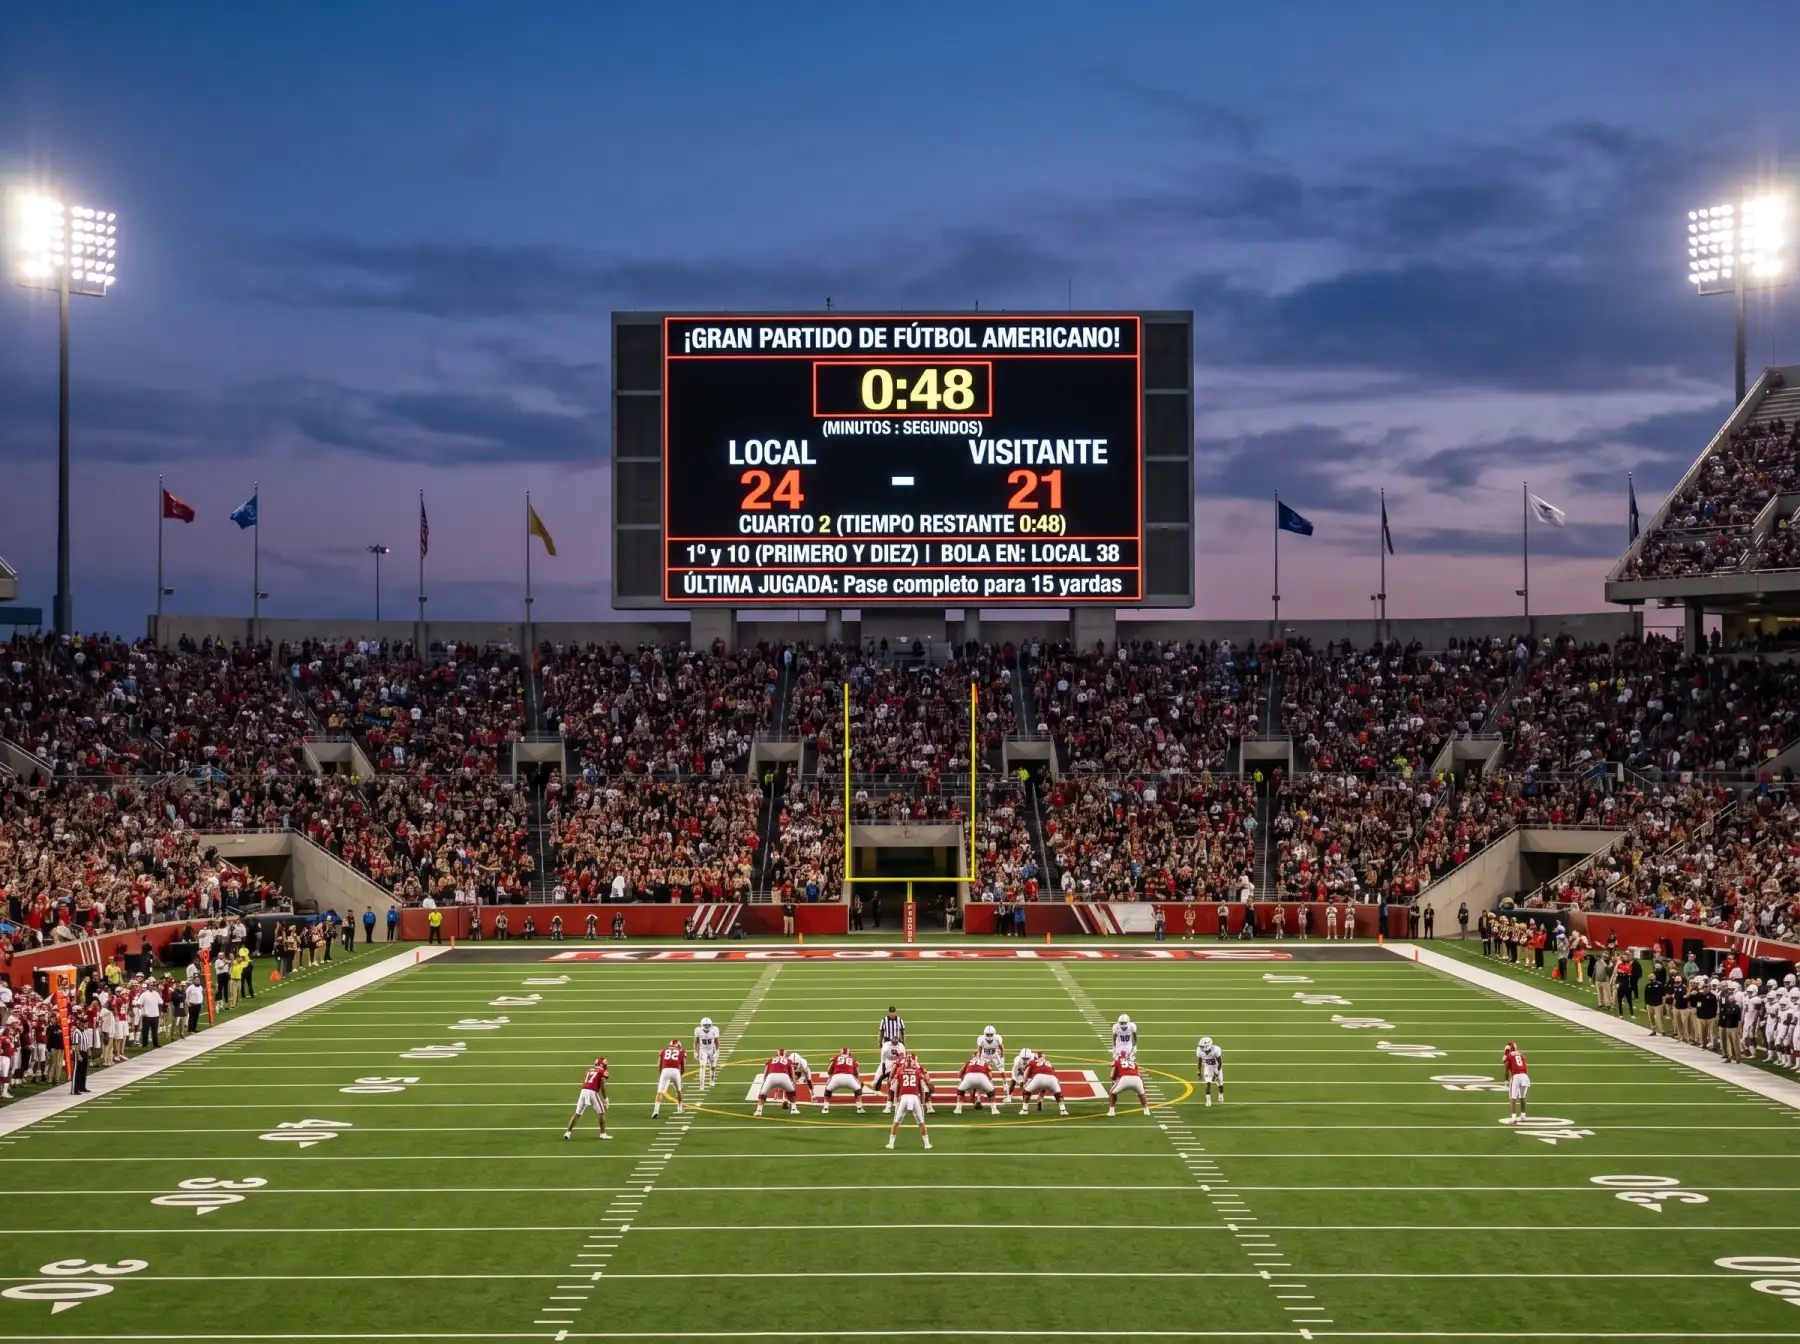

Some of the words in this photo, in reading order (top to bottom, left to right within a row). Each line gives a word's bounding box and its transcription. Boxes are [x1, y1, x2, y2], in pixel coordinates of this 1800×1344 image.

[684, 327, 753, 352] ¡GRAN
[759, 327, 853, 349] PARTIDO
[858, 327, 888, 349] DE
[893, 323, 978, 349] FÚTBOL
[981, 326, 1120, 349] AMERICANO!
[861, 368, 975, 410] 0:48
[822, 420, 892, 437] (MINUTOS
[902, 420, 984, 437] SEGUNDOS)
[728, 439, 817, 465] LOCAL
[968, 438, 1109, 465] VISITANTE
[740, 469, 805, 510] 24
[1007, 469, 1062, 510] 21
[738, 514, 815, 534] CUARTO
[818, 514, 831, 534] 2
[836, 514, 915, 535] (TIEMPO
[919, 513, 1015, 534] RESTANTE
[1019, 513, 1067, 535] 0:48)
[710, 548, 722, 566] y
[726, 544, 750, 563] 10
[755, 543, 848, 566] (PRIMERO
[851, 543, 866, 563] Y
[870, 543, 919, 566] DIEZ)
[941, 543, 991, 563] BOLA
[995, 543, 1026, 563] EN:
[1031, 543, 1092, 563] LOCAL
[1096, 543, 1120, 563] 38
[683, 570, 754, 594] ÚLTIMA
[757, 574, 839, 594] JUGADA:
[843, 574, 889, 594] Pase
[892, 574, 979, 598] completo
[983, 578, 1026, 598] para
[1031, 574, 1055, 594] 15
[1058, 573, 1123, 597] yardas
[258, 1118, 353, 1141] 40
[151, 1177, 268, 1207] 30
[1590, 1174, 1709, 1204] 30
[1, 1258, 149, 1300] 30
